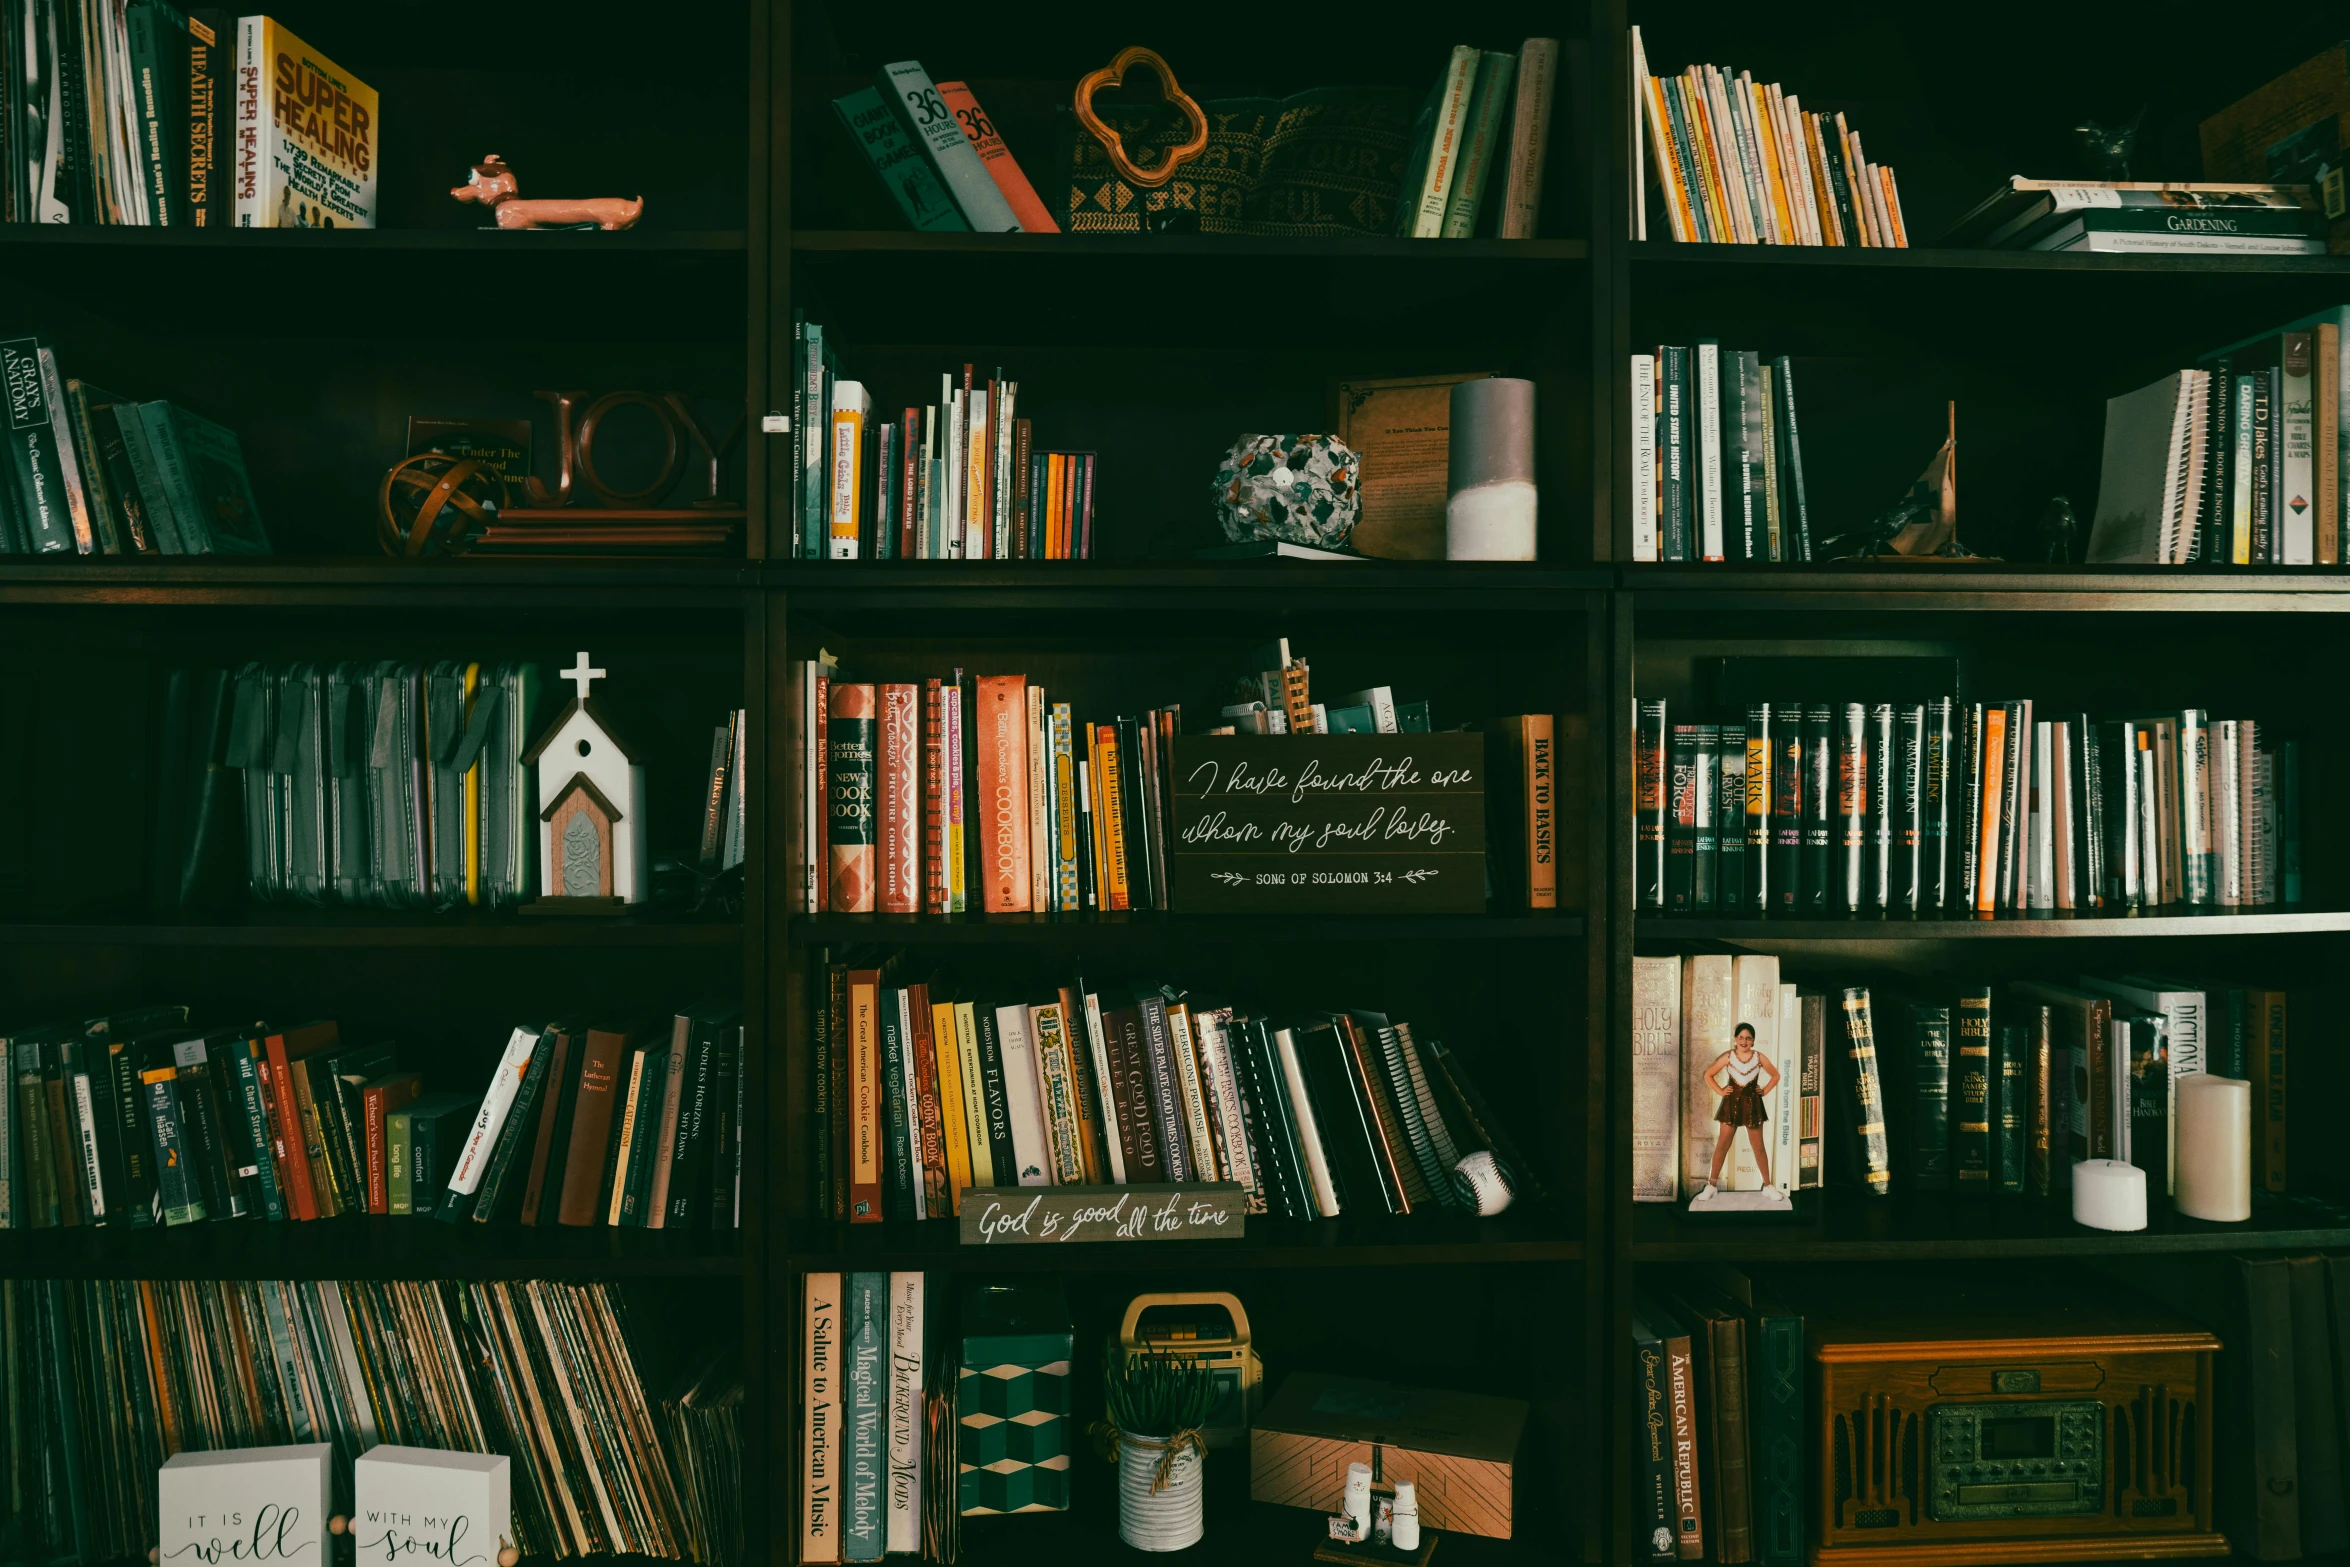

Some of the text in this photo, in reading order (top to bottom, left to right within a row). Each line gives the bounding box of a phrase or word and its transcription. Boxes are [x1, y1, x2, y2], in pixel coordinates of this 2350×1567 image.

[191, 46, 207, 118] HEALTH
[276, 52, 370, 145] SUPER
[60, 53, 74, 170] YEARBOOK 2002
[853, 105, 893, 128] GIANT
[907, 88, 948, 124] 36
[924, 120, 957, 136] HOURS
[956, 107, 994, 141] 36
[238, 68, 246, 200] UNLIMITED
[245, 66, 258, 200] SUPER HEALING
[274, 120, 368, 182] UNLIMITED
[275, 88, 370, 172] HEALING
[282, 139, 308, 162] 1,739
[864, 120, 901, 146] BOOK
[973, 138, 1002, 152] HOURS
[190, 122, 207, 204] SECRETS
[875, 144, 917, 171] GAMES
[1434, 155, 1448, 193] WORLD
[2166, 216, 2238, 232] GARDENING
[2, 347, 29, 422] ANATOMY
[524, 391, 747, 509] JOY
[1670, 384, 1680, 482] UNITED STATES HISTORY
[2239, 385, 2251, 486] DARING GREATLY
[2254, 395, 2268, 460] T.D. Jakes
[461, 446, 520, 459] Under The
[1742, 450, 1754, 558] The SURVIVAL MEDICINE Handbook
[2260, 464, 2268, 552] God's Leading Lady
[830, 786, 872, 800] COOK
[836, 772, 860, 782] NEW
[1672, 764, 1687, 818] FORCE
[1748, 748, 1762, 806] MARK
[1906, 738, 1918, 814] ARMAGEDDON
[1928, 735, 1940, 804] INDWELLING
[830, 803, 872, 818] BOOK
[996, 711, 1015, 881] Betty Crocker's COOKBOOK
[1062, 782, 1070, 836] DESSERTS
[1534, 738, 1551, 866] BACK TO BASICS
[1256, 872, 1392, 886] SONG OF SOLOMON 3:4
[1743, 1003, 1774, 1019] Bible
[1746, 982, 1773, 1003] Holy
[1632, 1006, 1673, 1031] HOLY
[1961, 1018, 1990, 1028] HOLY
[1961, 1028, 1990, 1038] BIBLE
[592, 1060, 606, 1070] The
[1632, 1033, 1674, 1056] BIBLE
[1921, 1040, 1946, 1049] LIVING
[1924, 1050, 1944, 1058] BIBLE
[120, 1056, 136, 1129] RICHARD WRIGHT
[583, 1069, 611, 1082] Lutheran
[583, 1082, 608, 1094] Hymnal
[692, 1040, 711, 1141] ENDLESS HORIZONS:
[886, 1024, 904, 1128] market vegetarian
[1124, 1022, 1156, 1168] GREAT GOOD FOOD
[1181, 1027, 1206, 1135] PERRICONE PROMISE
[1784, 1059, 1792, 1087] Stories
[1962, 1082, 1988, 1091] JAMES
[155, 1116, 168, 1148] Hiaasen
[165, 1120, 175, 1140] Carl
[677, 1111, 692, 1162] SHY DAWN
[392, 1143, 401, 1179] long life
[414, 1146, 424, 1183] comfort
[979, 1192, 1230, 1244] God is good all the time
[286, 1361, 296, 1378] HEY
[810, 1297, 833, 1538] A Salute to American Music
[1640, 1348, 1664, 1462] Great Stories Remembered
[848, 1344, 878, 1541] Magical World of Melody
[890, 1351, 921, 1511] BACKGROUND MOODS
[1671, 1354, 1694, 1514] AMERICAN REPUBLIC
[189, 1513, 242, 1528] IT IS
[366, 1510, 449, 1530] WITH MY
[1656, 1474, 1665, 1521] WHEELER
[163, 1503, 317, 1566] well
[358, 1515, 488, 1566] soul
[1333, 1529, 1356, 1538] S'MORE
